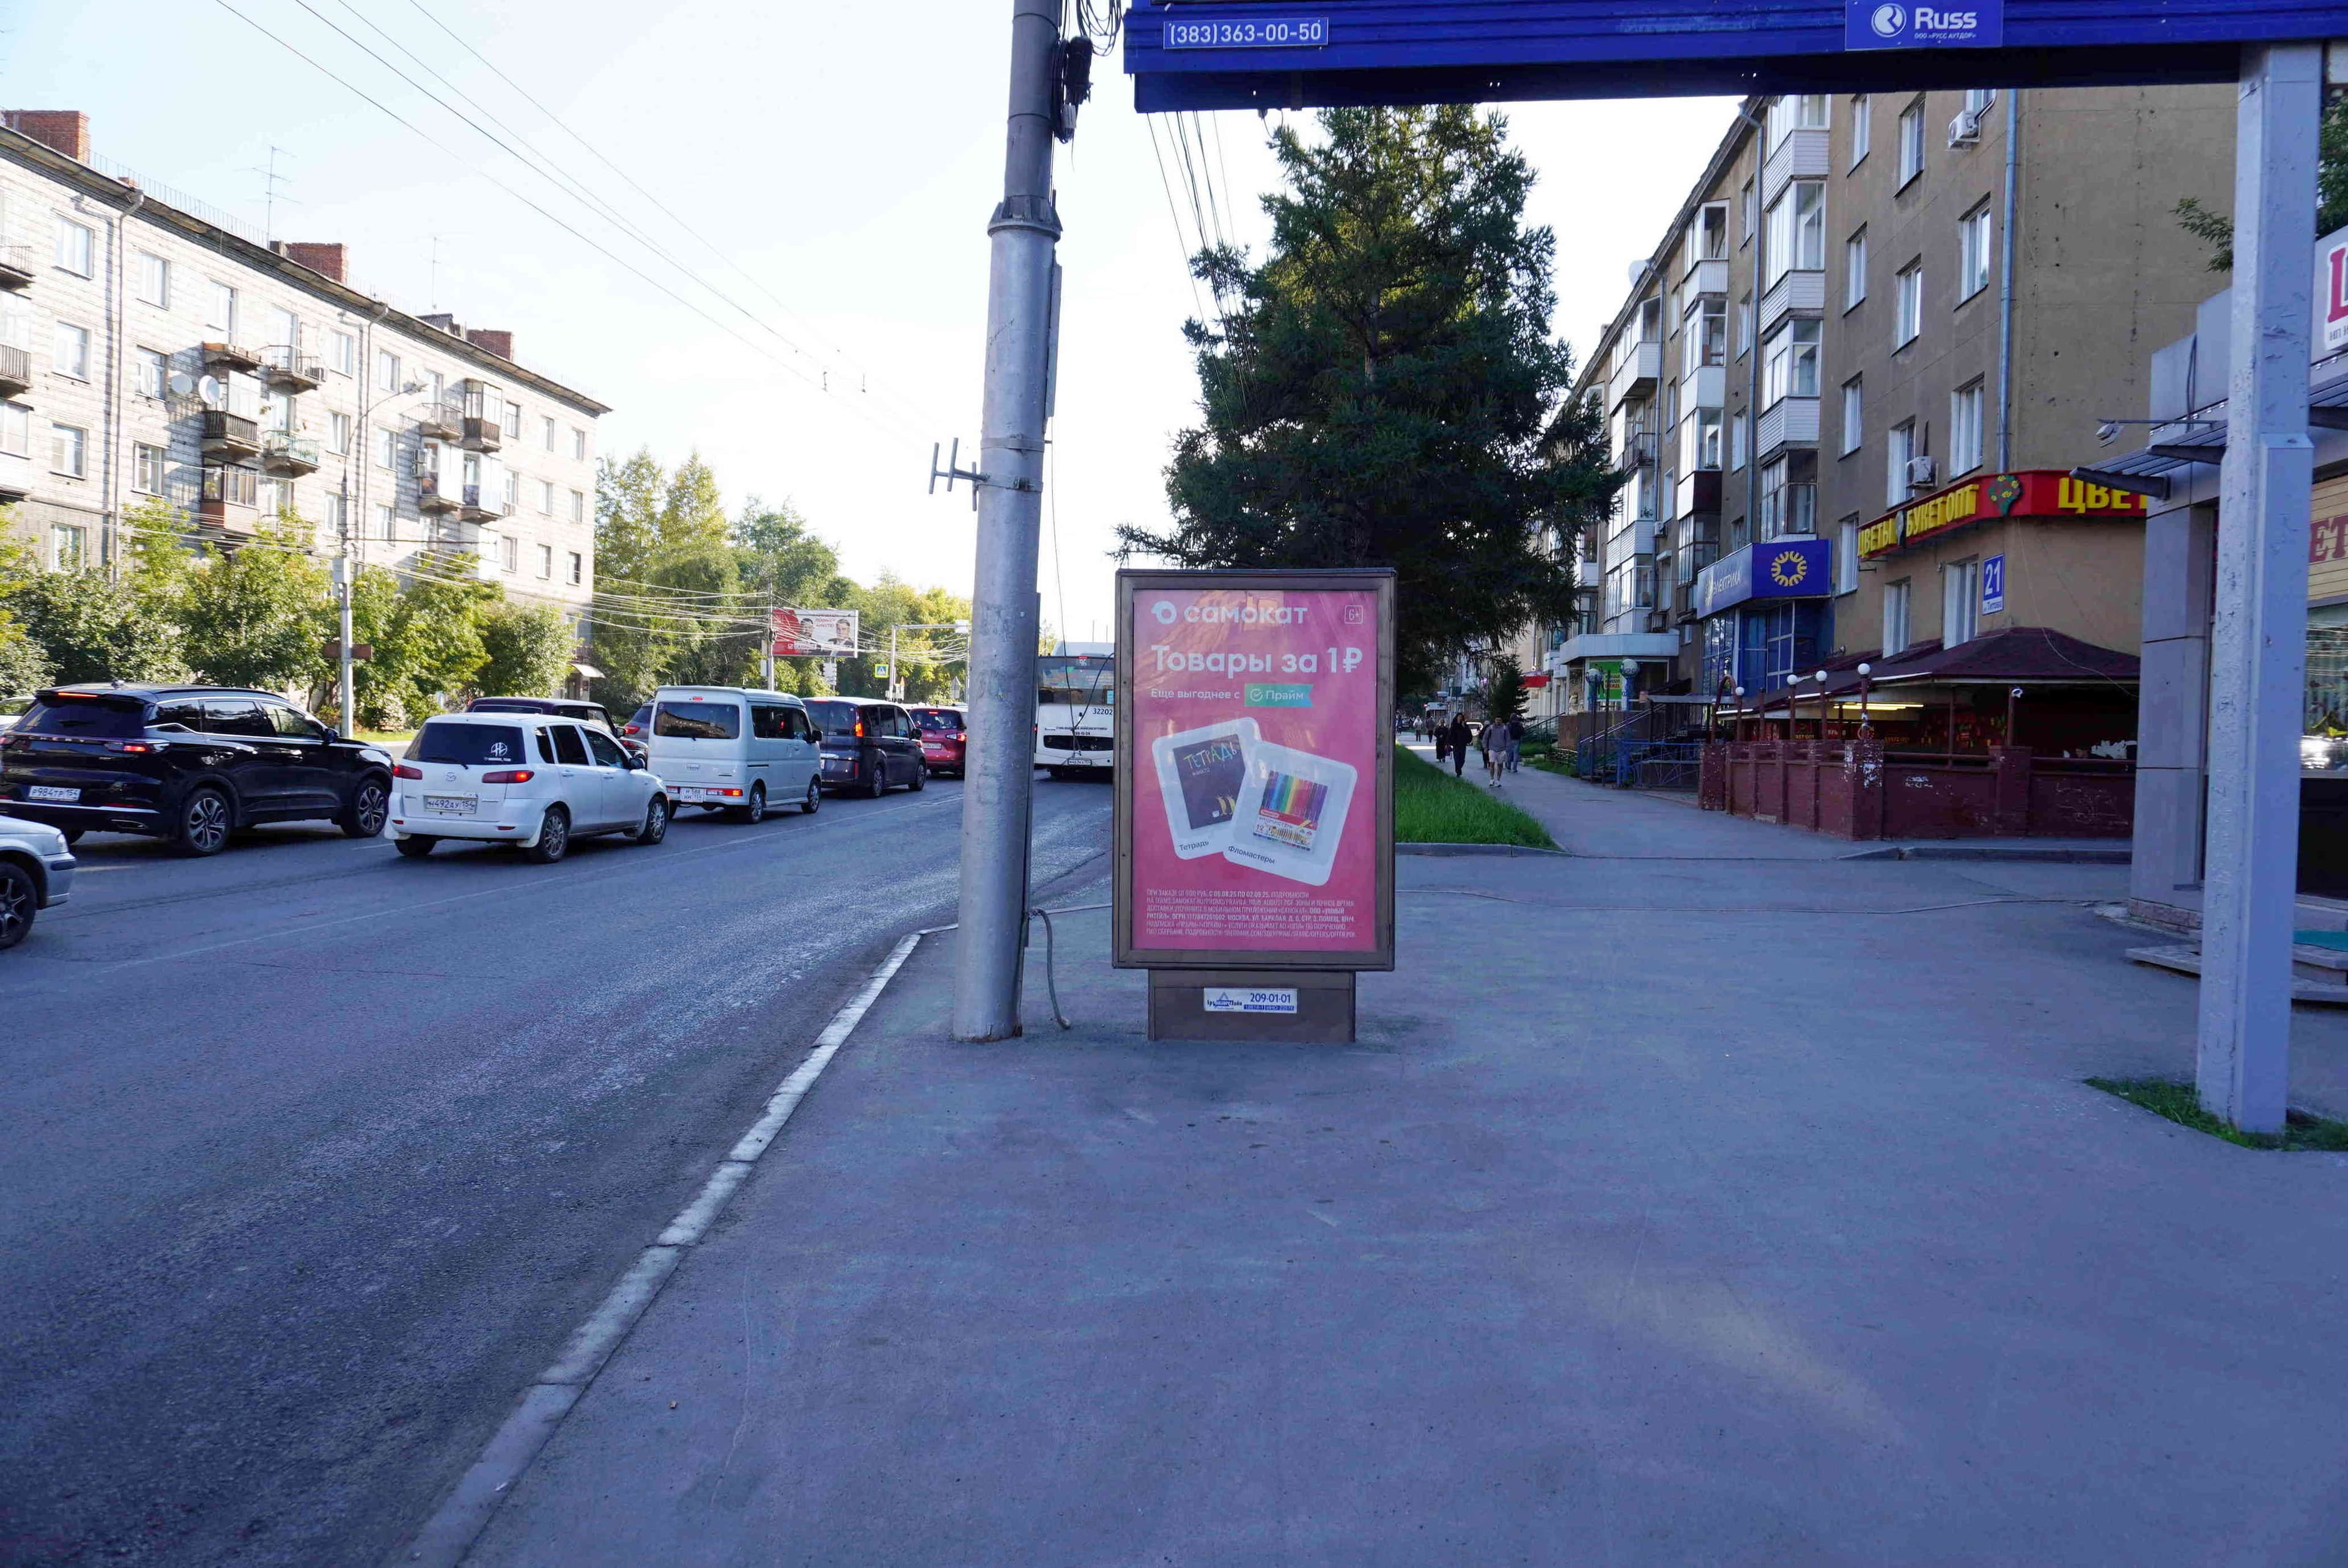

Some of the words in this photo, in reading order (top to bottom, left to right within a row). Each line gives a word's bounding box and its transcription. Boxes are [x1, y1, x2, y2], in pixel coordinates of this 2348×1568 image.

[1914, 7, 1977, 29] Russ
[1858, 518, 1897, 559] ЦВЕТЫ
[1985, 560, 2001, 596] 21
[1184, 605, 1307, 624] самокат
[1348, 608, 1360, 621] 6+
[1151, 645, 1271, 679] Товары
[1282, 653, 1317, 673] за
[1151, 689, 1175, 701] Еще
[1177, 691, 1231, 701] выгоднее
[1266, 690, 1304, 701] Прайм
[1183, 742, 1237, 770] ТЕТРАДЬ
[1179, 840, 1209, 851] Тетрадь
[1228, 845, 1275, 864] Фломастеры
